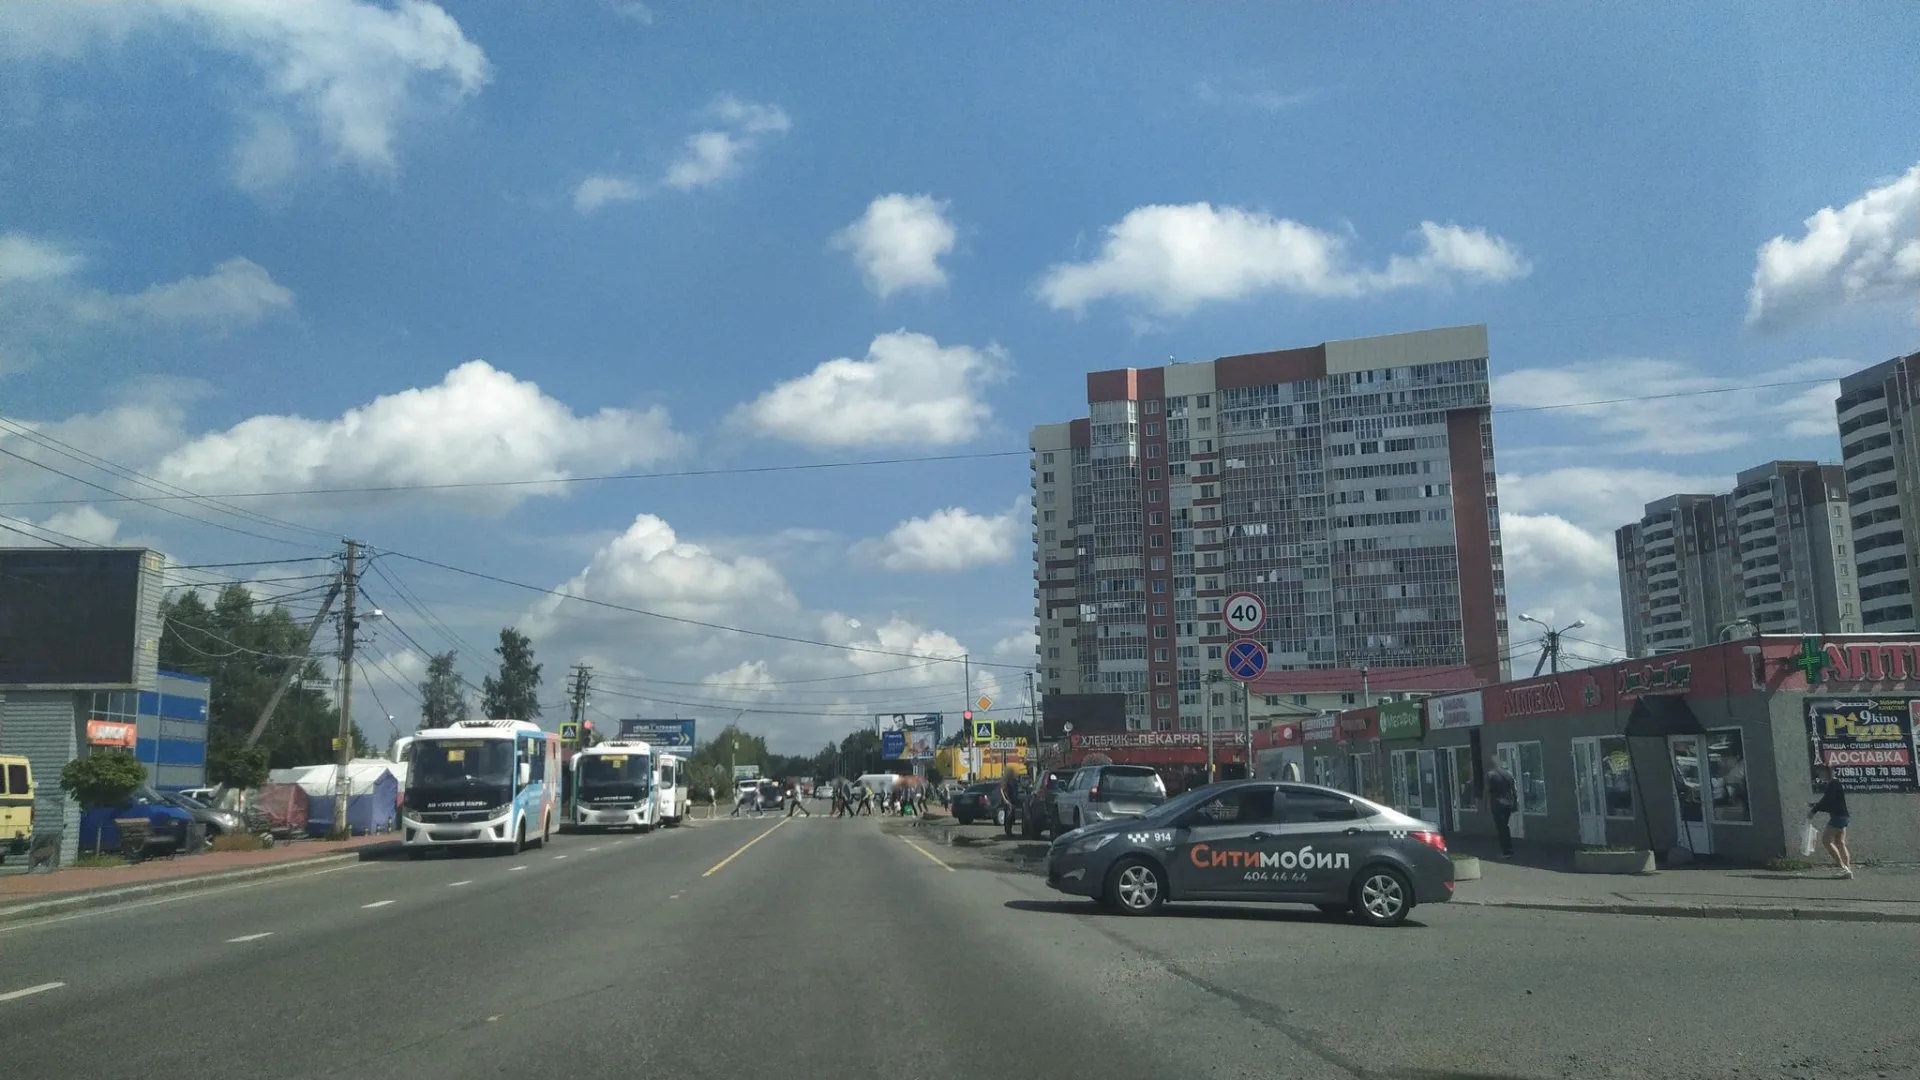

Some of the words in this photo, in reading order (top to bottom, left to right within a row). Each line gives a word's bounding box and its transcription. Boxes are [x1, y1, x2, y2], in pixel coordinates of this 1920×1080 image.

[1231, 604, 1257, 621] 40
[1821, 642, 1920, 681] АПТ
[1824, 713, 1903, 741] Pizza
[1080, 735, 1129, 745] ХЛЕБНИК
[1138, 733, 1201, 744] ПЕКАРНЯ
[1829, 751, 1904, 765] ДОСТАВКА
[1154, 832, 1172, 842] 914
[1190, 843, 1350, 869] Ситимобил
[1243, 871, 1268, 882] 404
[1271, 871, 1288, 882] 44
[1291, 871, 1308, 882] 44
